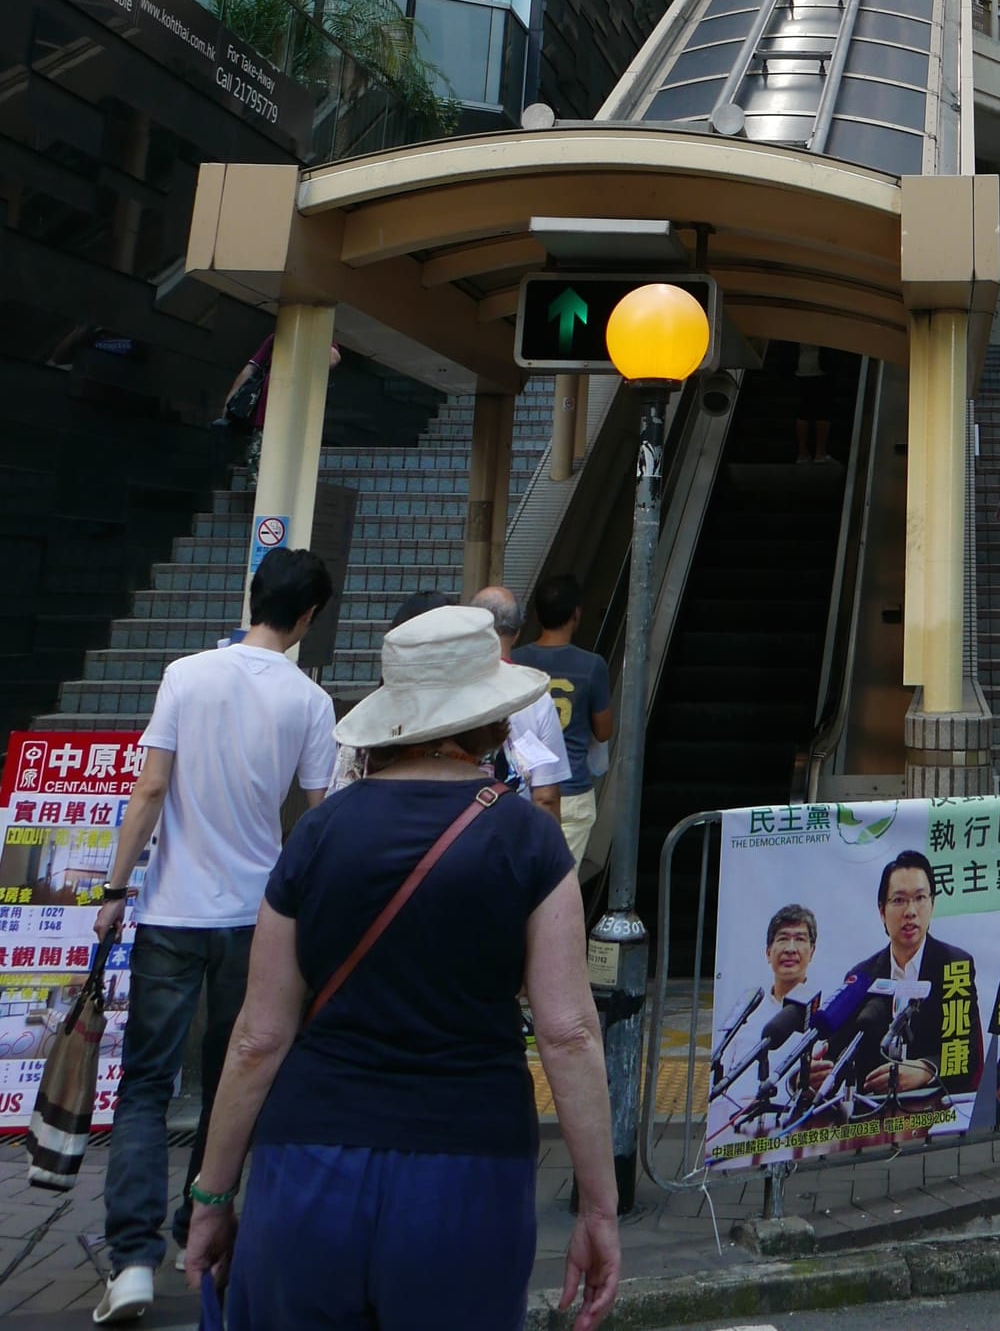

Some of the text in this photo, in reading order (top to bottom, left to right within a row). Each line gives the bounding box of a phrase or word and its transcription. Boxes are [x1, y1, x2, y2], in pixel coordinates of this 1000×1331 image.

[227, 43, 276, 95] For Take-Away
[215, 66, 278, 125] Call 21795779
[44, 780, 118, 794] CENTALINE
[13, 800, 113, 826] 實用單位
[750, 803, 831, 835] 民主黨
[731, 833, 831, 849] THE DEMOCRATIC PARTY
[41, 907, 65, 917] 1027
[39, 920, 62, 931] 1348
[939, 959, 973, 1078] 吳兆康
